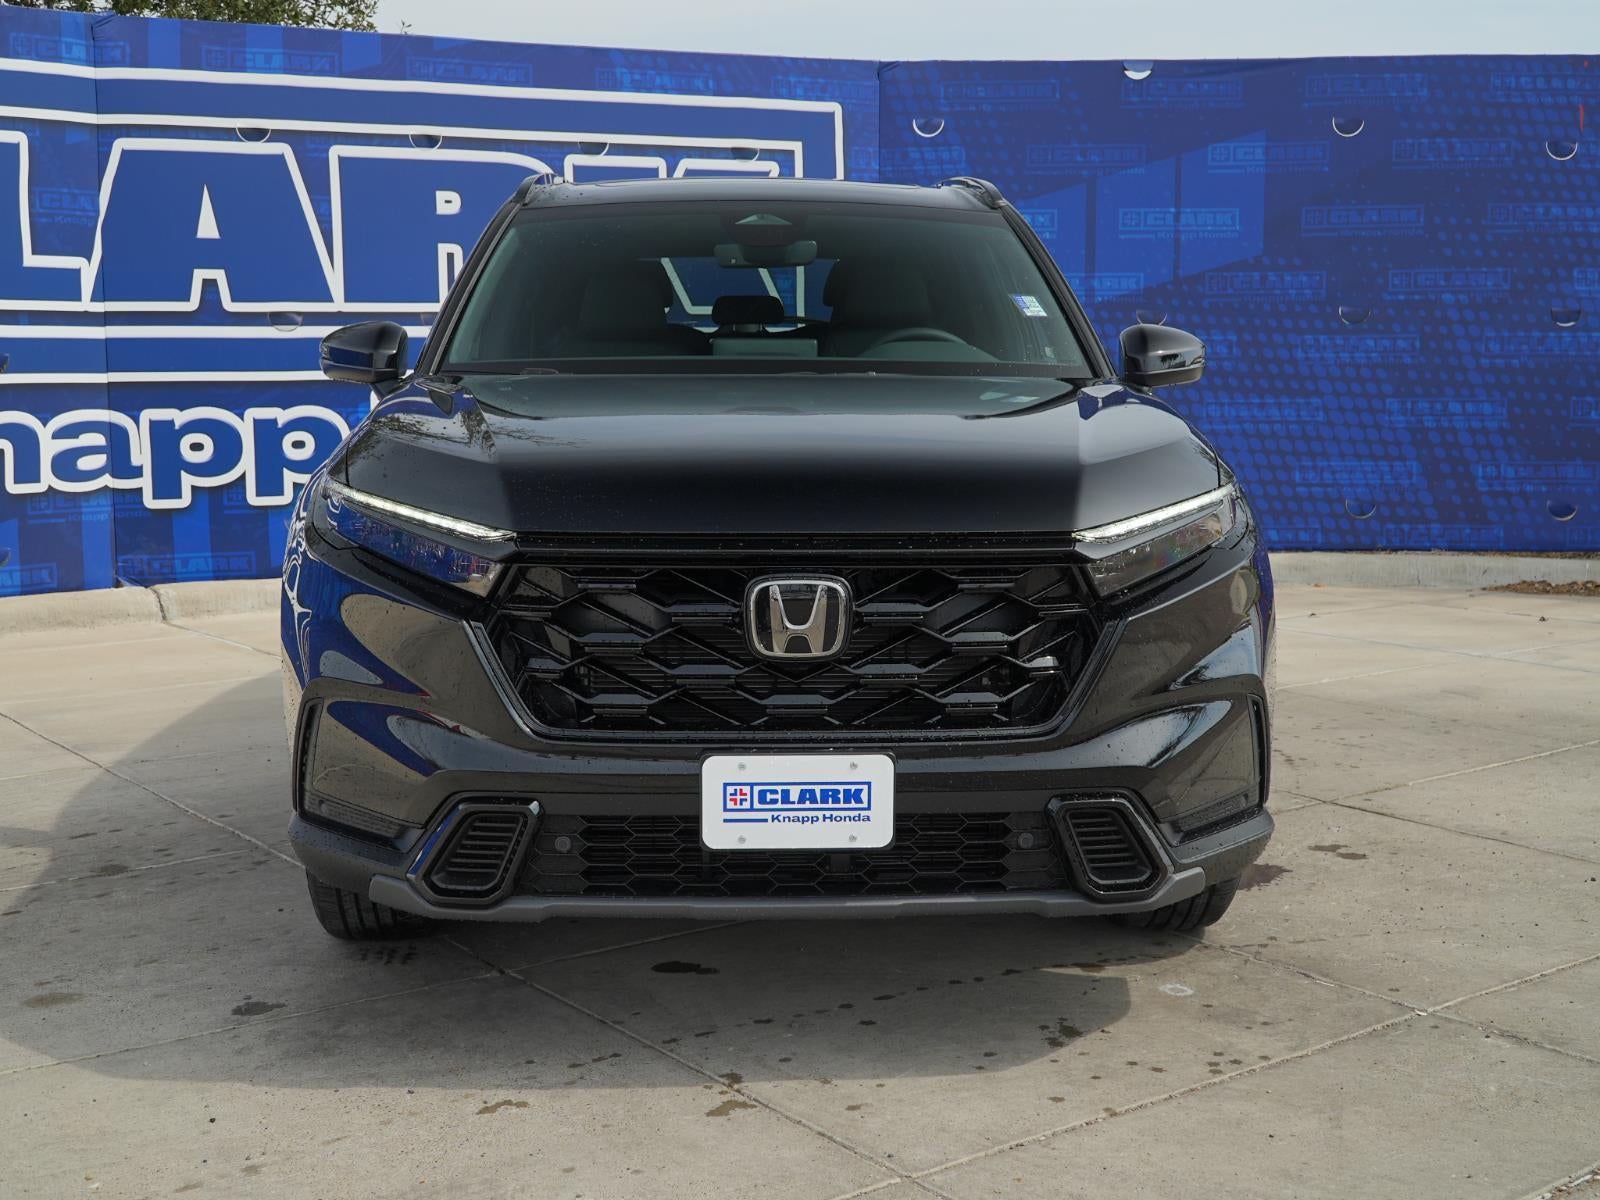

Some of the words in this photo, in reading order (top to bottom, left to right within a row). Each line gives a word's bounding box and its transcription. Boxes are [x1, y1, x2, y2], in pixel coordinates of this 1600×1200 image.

[1145, 211, 1234, 225] CLARK
[757, 788, 864, 805] CLARK
[771, 813, 819, 825] Knapp
[822, 813, 871, 823] Honda
